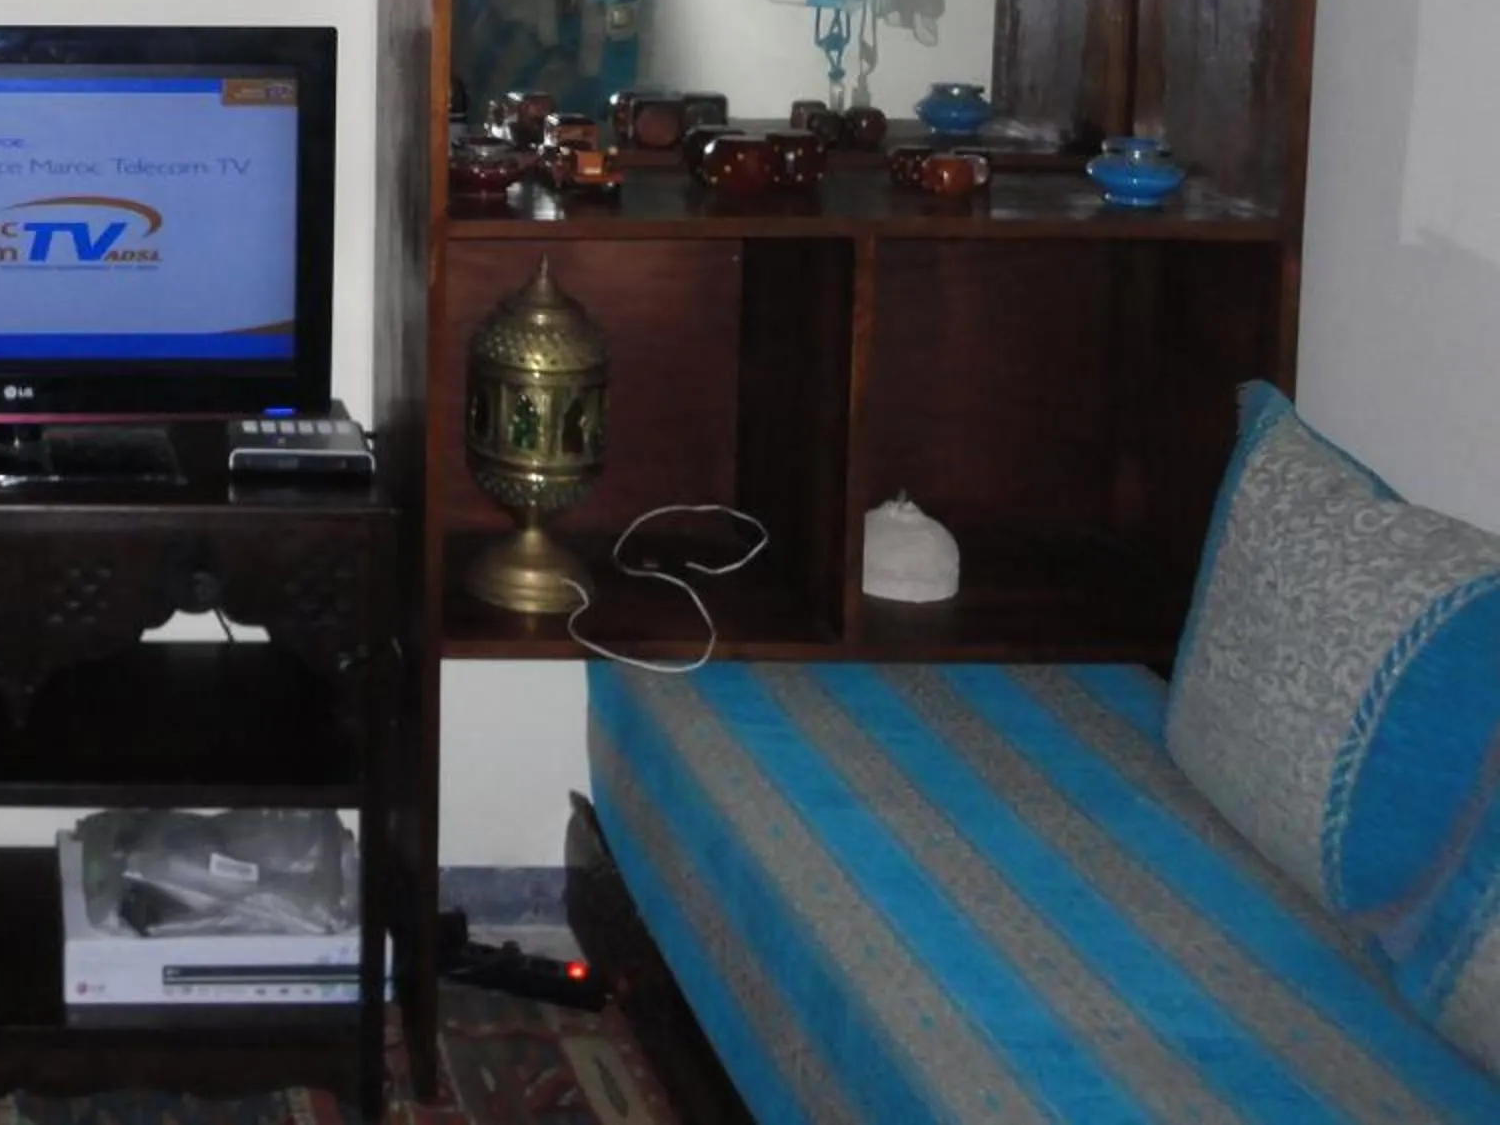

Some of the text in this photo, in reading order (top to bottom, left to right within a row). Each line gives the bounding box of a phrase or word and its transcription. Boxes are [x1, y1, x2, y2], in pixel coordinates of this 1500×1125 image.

[30, 158, 98, 175] Maroc
[110, 158, 208, 176] Telecom
[217, 158, 250, 175] TV
[23, 221, 127, 262] TV
